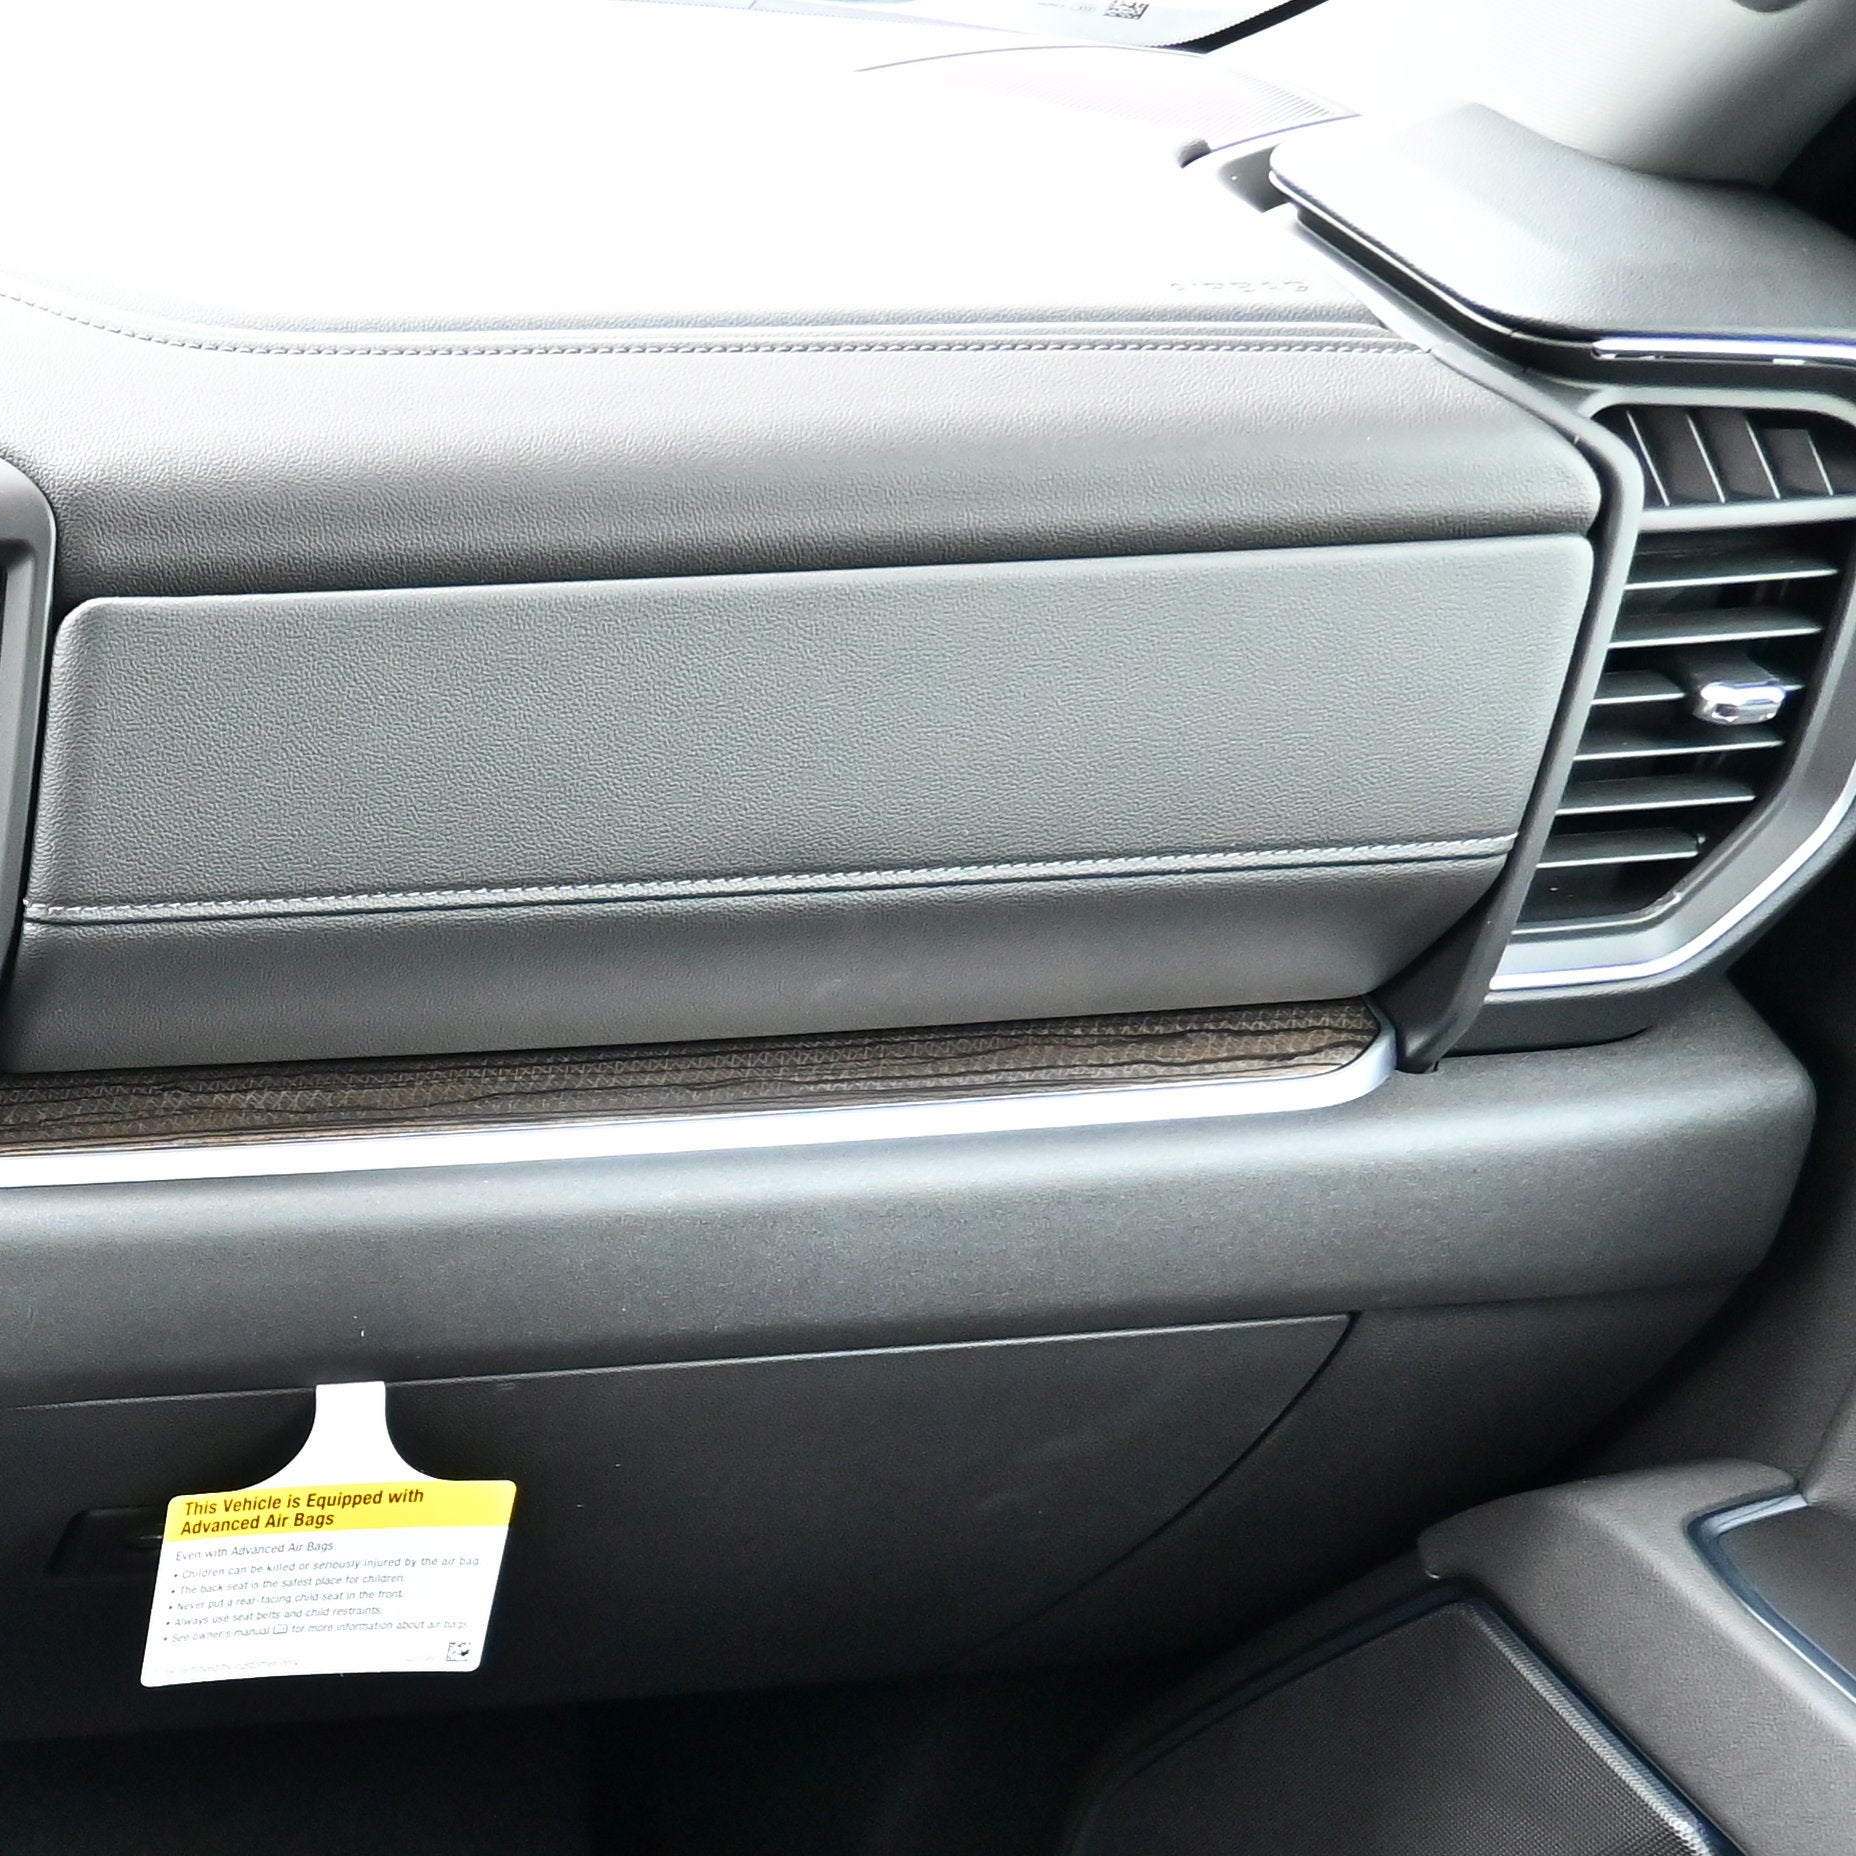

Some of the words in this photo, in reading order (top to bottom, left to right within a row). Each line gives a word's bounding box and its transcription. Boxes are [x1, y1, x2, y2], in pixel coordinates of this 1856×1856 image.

[185, 1501, 217, 1516] This
[223, 1495, 282, 1513] Vehicle
[287, 1494, 301, 1509] is
[306, 1490, 384, 1510] Equipped
[388, 1489, 424, 1504] with
[180, 1515, 261, 1535] Advanced
[265, 1514, 289, 1528] Air
[293, 1512, 334, 1529] Bags
[176, 1551, 201, 1562] Even
[205, 1547, 228, 1558] with
[231, 1543, 285, 1556] Advanced
[288, 1543, 303, 1552] Air
[182, 1566, 225, 1579] Children
[228, 1565, 247, 1575] can
[250, 1563, 263, 1573] be
[267, 1561, 296, 1572] killed
[298, 1562, 309, 1570] or
[313, 1559, 360, 1571] seriously
[364, 1558, 401, 1568] injured
[404, 1558, 417, 1568] by
[421, 1557, 438, 1566] the
[200, 1582, 223, 1593] back
[226, 1581, 248, 1591] seat
[263, 1579, 278, 1589] the
[281, 1577, 313, 1587] safest
[315, 1576, 342, 1586] place
[345, 1575, 359, 1585] for
[208, 1600, 224, 1609] put
[295, 1592, 319, 1603] child
[322, 1592, 343, 1601] seat
[346, 1590, 356, 1600] in
[359, 1590, 375, 1599] the
[233, 1613, 254, 1622] seat
[256, 1611, 280, 1620] belts
[283, 1609, 303, 1619] and
[305, 1607, 330, 1617] child
